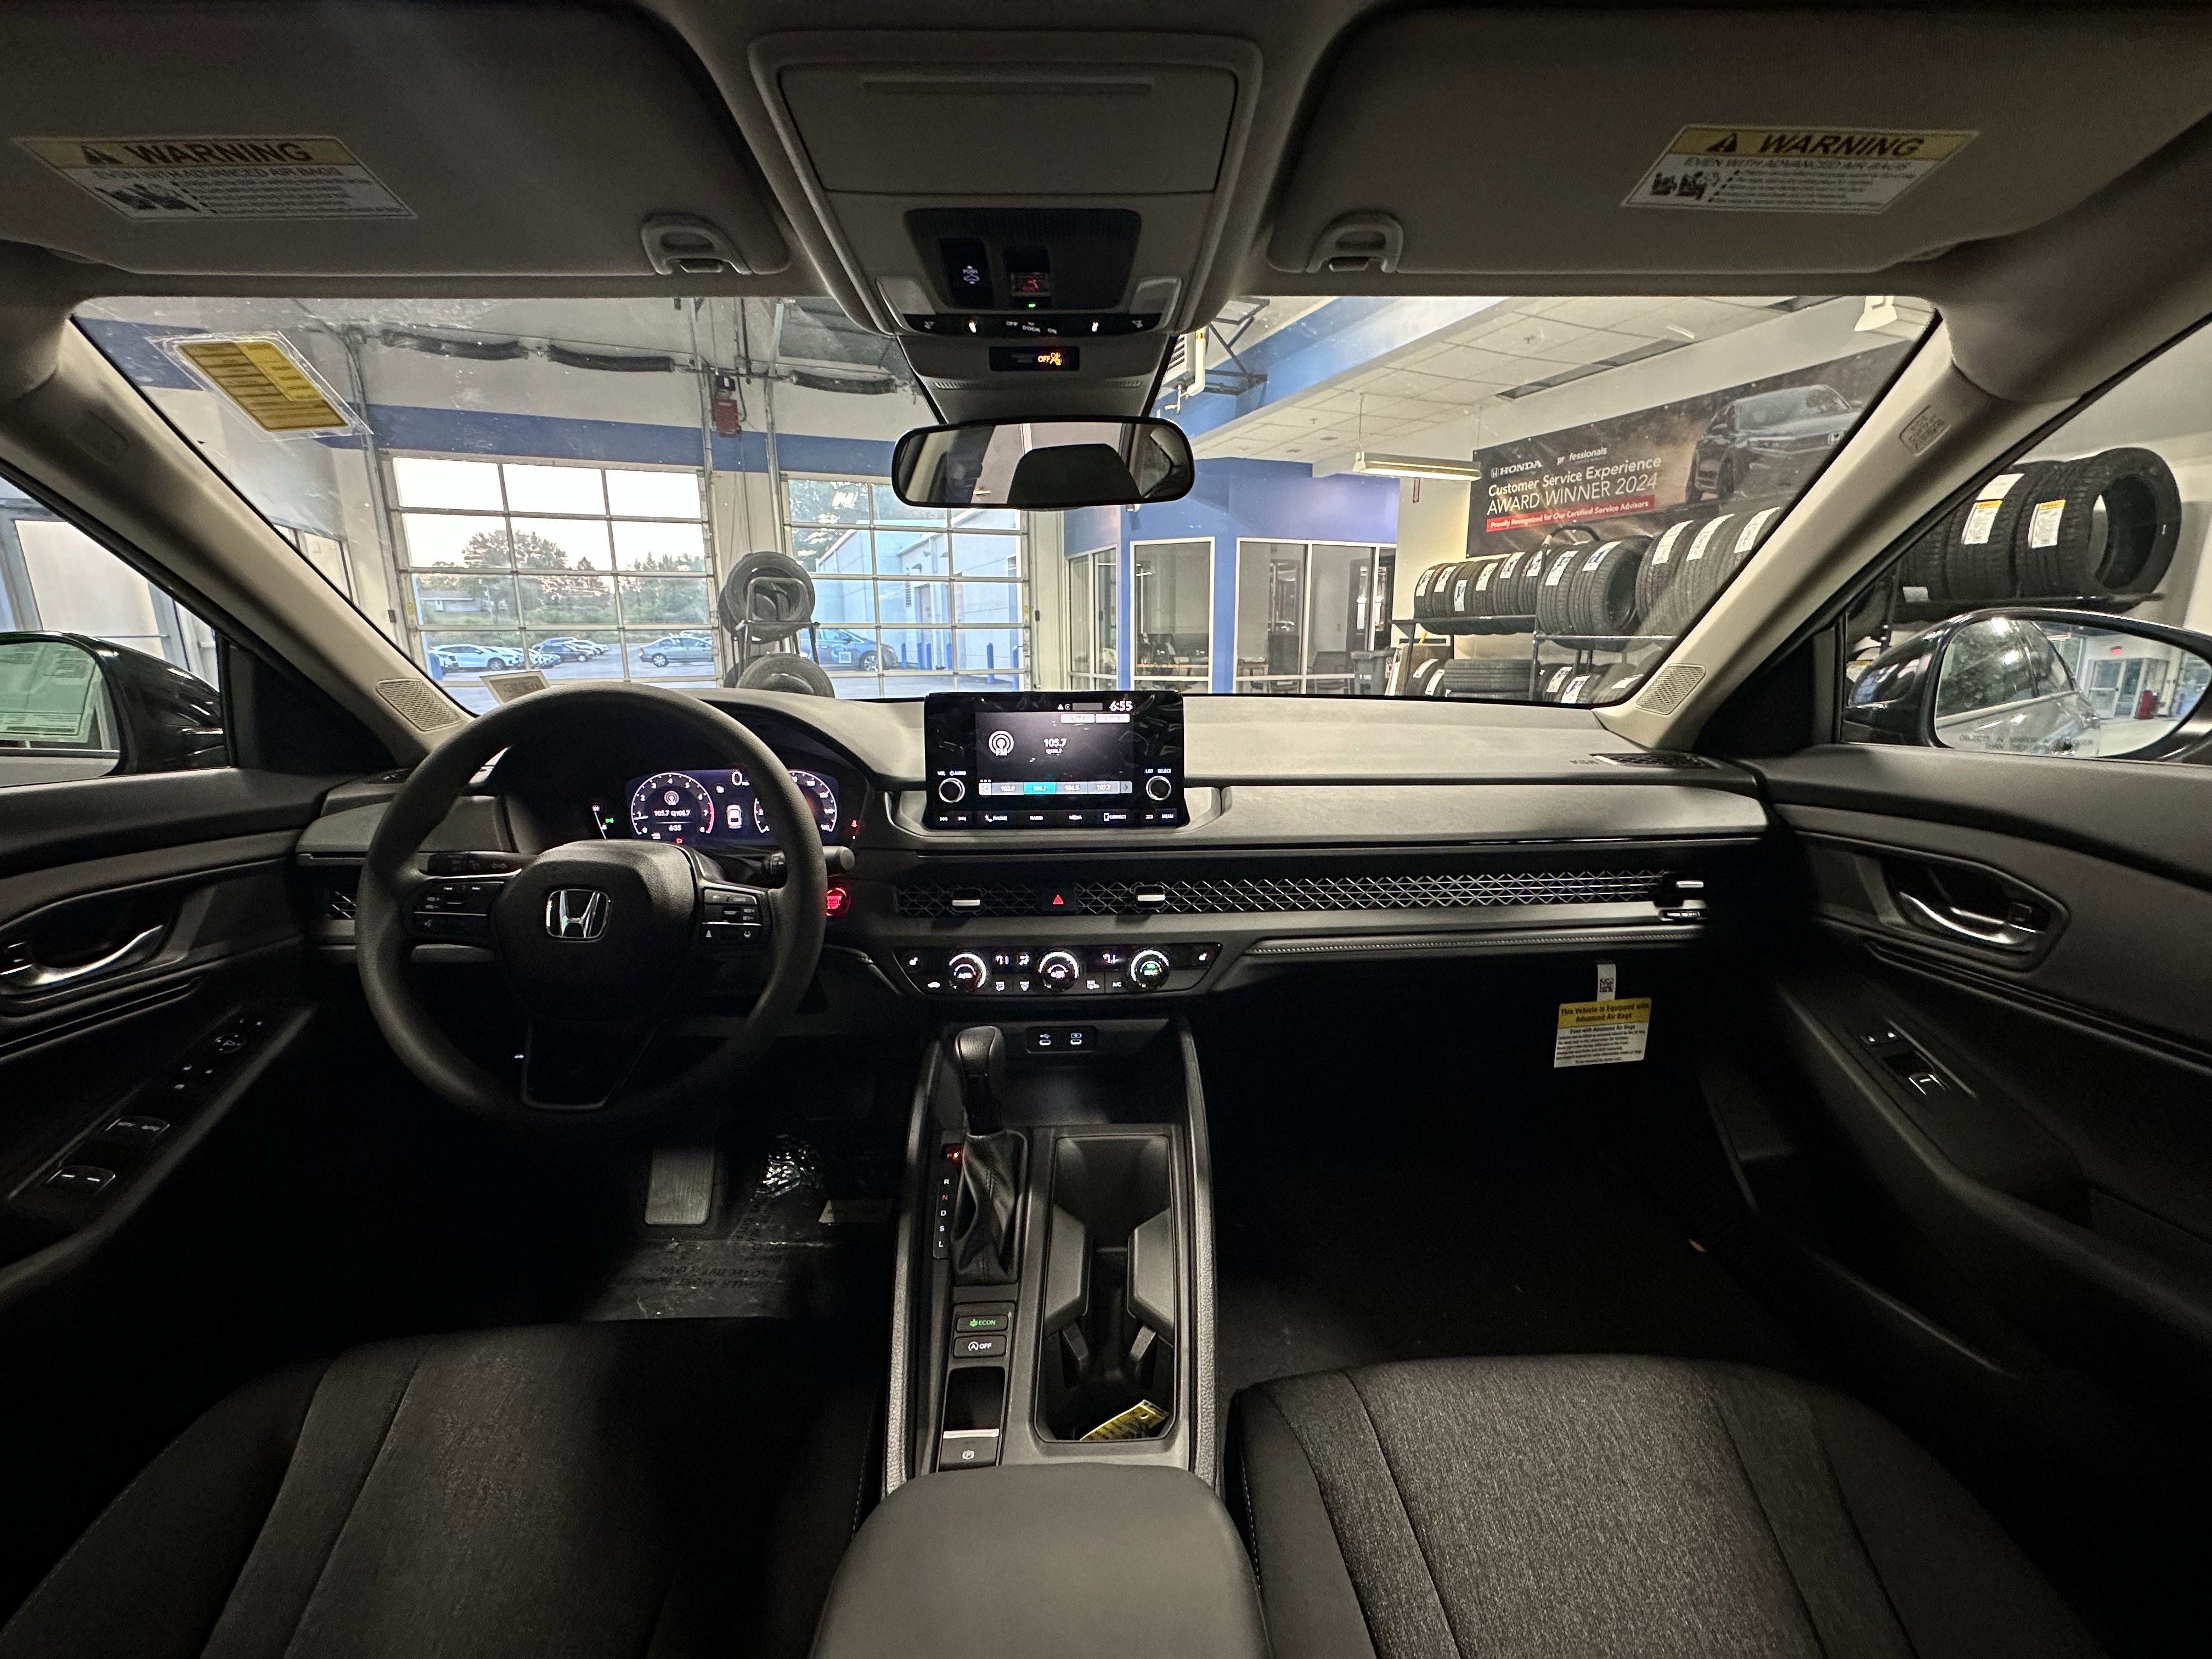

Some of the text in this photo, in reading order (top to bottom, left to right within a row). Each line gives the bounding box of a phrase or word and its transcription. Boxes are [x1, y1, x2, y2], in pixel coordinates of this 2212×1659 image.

[123, 143, 313, 163] WARNING
[1758, 134, 1925, 156] WARNING
[1499, 460, 1543, 476] HONDA
[1488, 479, 1539, 497] Customer
[1543, 471, 1582, 487] Service
[1586, 456, 1661, 481] Experience
[1487, 472, 1658, 515] AWARD WINNER 2024
[1490, 500, 1649, 528] Proudly Recognized for Our Certified Service Advisors
[1110, 701, 1132, 712] 6:55
[1043, 738, 1067, 748] 105.7
[731, 770, 743, 786] 0
[1575, 1006, 1598, 1015] Vehicle
[1607, 1003, 1635, 1012] Equipped
[1576, 1014, 1605, 1023] Advanced
